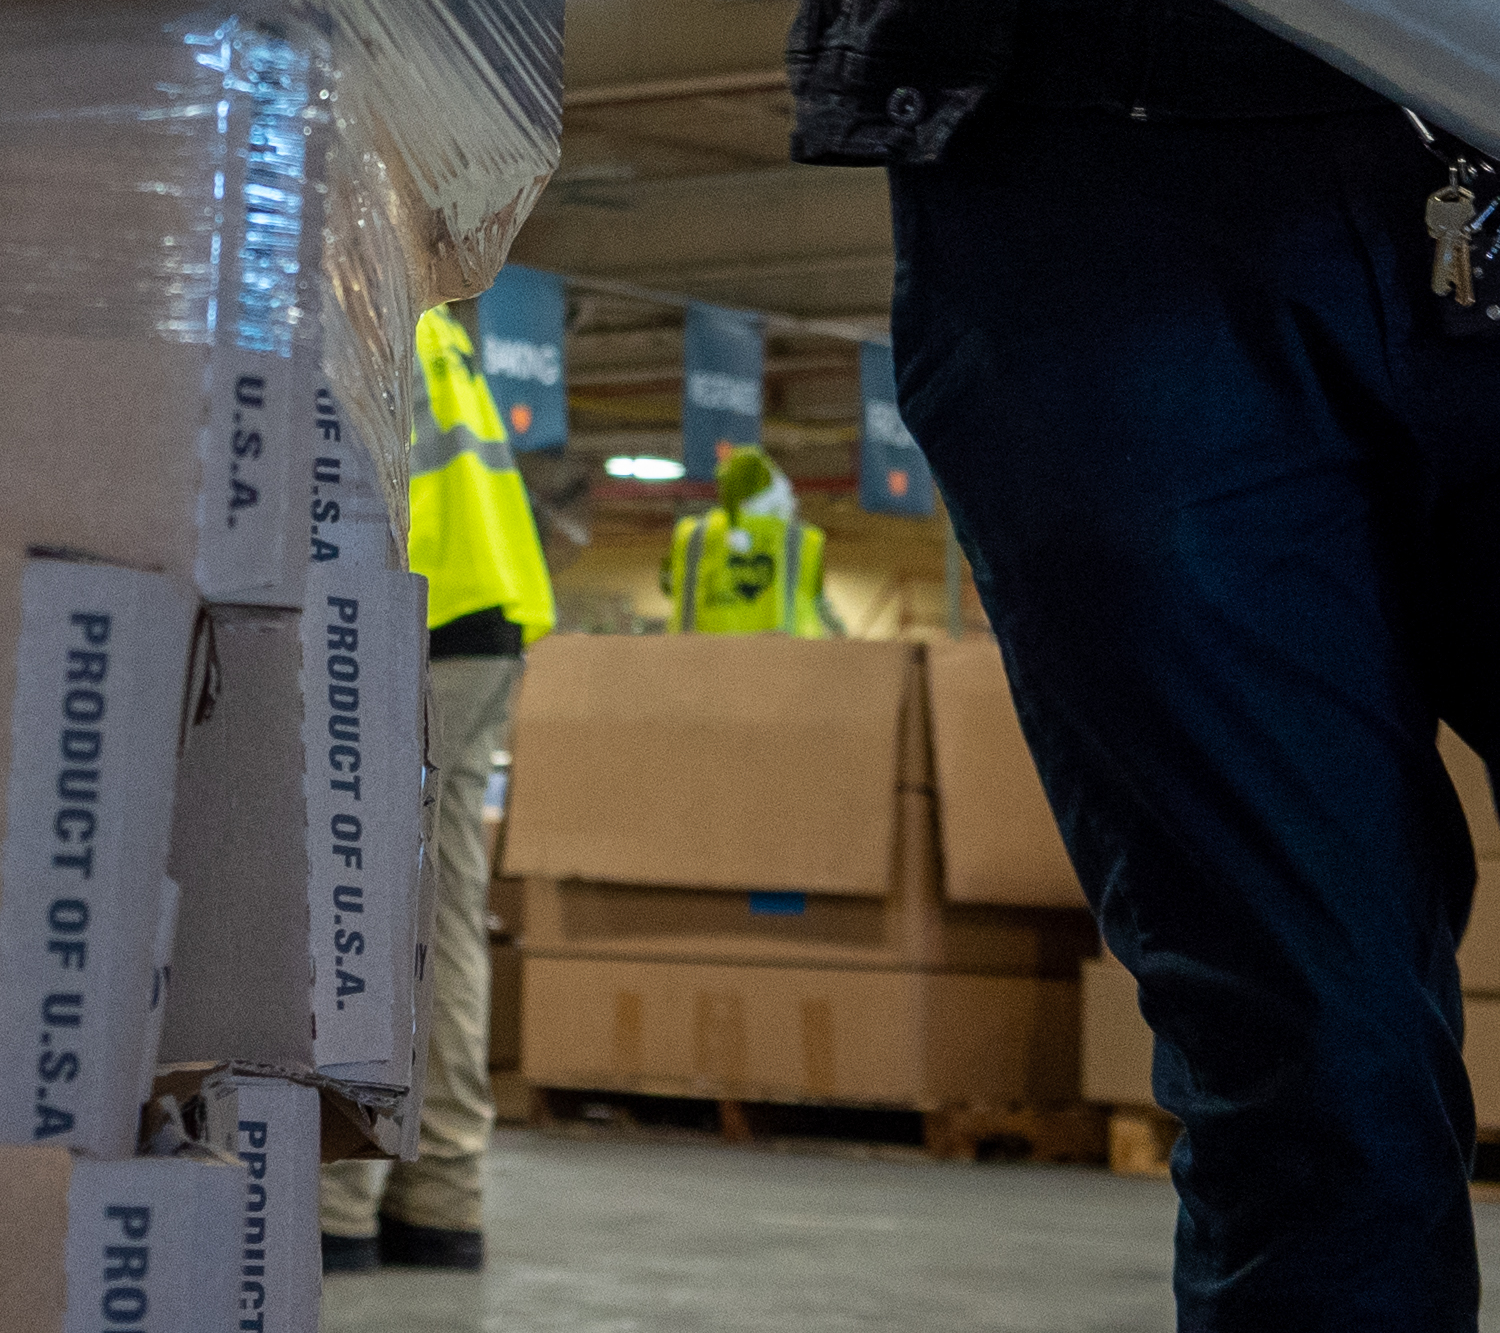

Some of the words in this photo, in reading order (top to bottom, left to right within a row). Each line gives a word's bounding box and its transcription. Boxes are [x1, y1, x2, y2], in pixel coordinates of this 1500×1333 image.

[226, 375, 266, 529] U.S.A.
[53, 608, 112, 880] PRODUCT
[325, 595, 364, 801] PRODUCT
[330, 812, 364, 871] OF
[45, 898, 91, 973] OF
[332, 883, 367, 1012] U.S.A.
